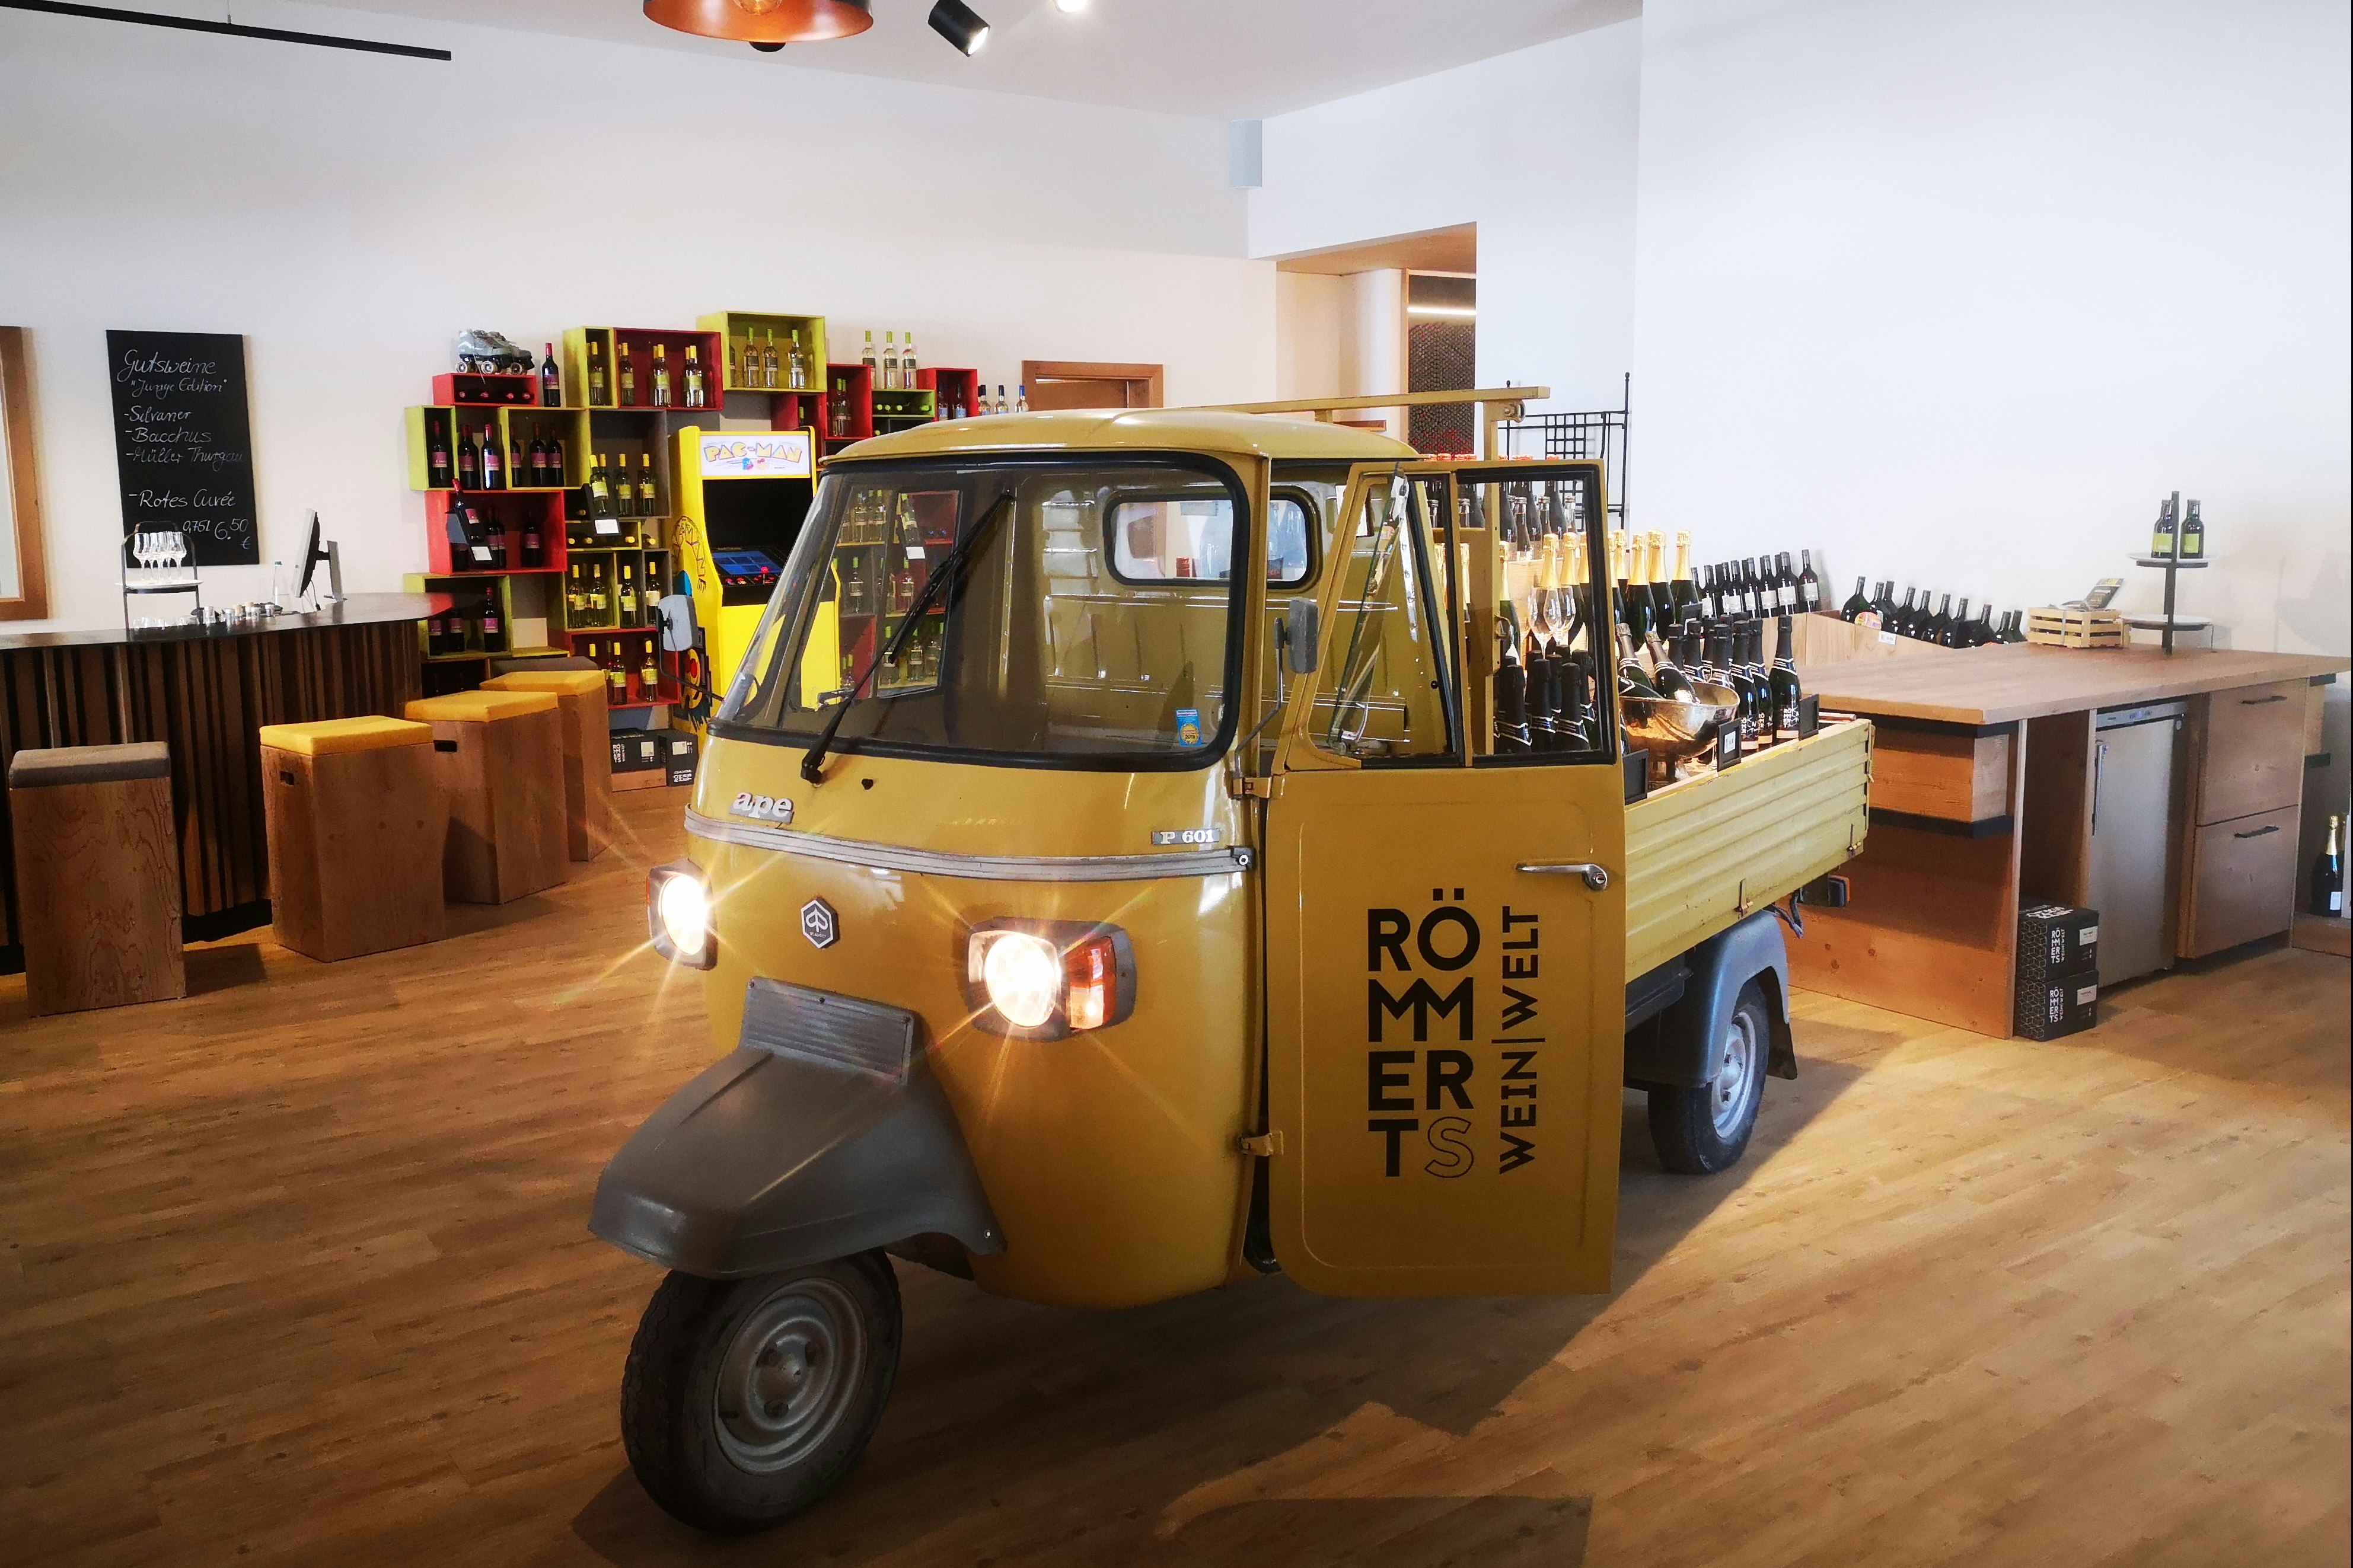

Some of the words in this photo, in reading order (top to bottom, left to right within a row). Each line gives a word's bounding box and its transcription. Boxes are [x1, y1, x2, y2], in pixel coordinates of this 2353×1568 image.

[117, 349, 217, 382] Gutsweine
[704, 442, 802, 463] PAC-MAN
[193, 488, 236, 507] Cuvée
[732, 792, 793, 819] ape
[1160, 831, 1175, 844] P
[1182, 829, 1214, 844] 601
